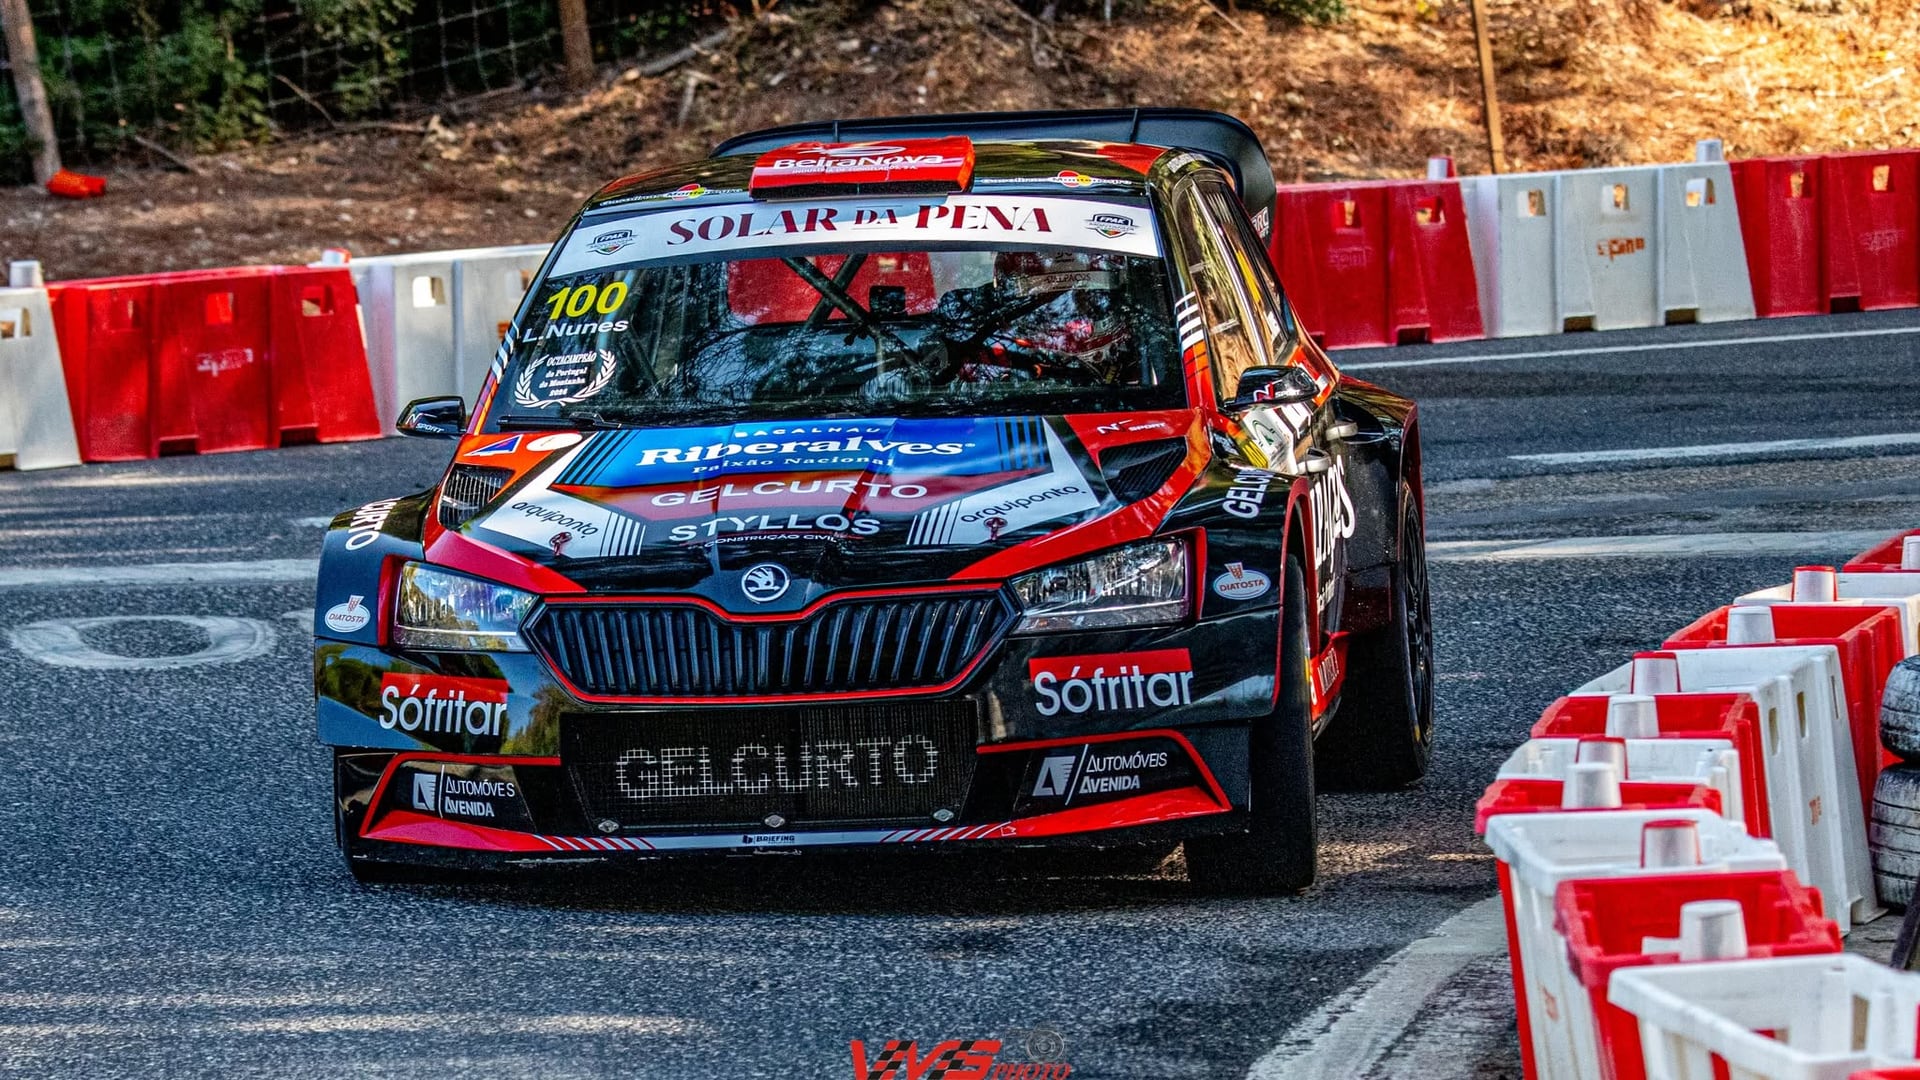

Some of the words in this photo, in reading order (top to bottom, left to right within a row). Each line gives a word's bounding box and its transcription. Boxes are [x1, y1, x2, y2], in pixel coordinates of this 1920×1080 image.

[772, 154, 945, 171] BeiraNova
[666, 207, 839, 246] SOLAR
[853, 207, 899, 225] DA
[914, 204, 1053, 233] PENA
[546, 281, 629, 321] 100
[522, 319, 630, 344] L.Nunes
[554, 366, 589, 377] Portugal
[415, 422, 445, 434] SPORT
[733, 426, 881, 439] BACALHAU
[691, 458, 775, 475] Paixão
[783, 454, 894, 468] Nacional
[650, 478, 929, 507] GELCURTO
[344, 496, 402, 551] CURTO
[667, 512, 882, 543] STYLLOS
[704, 533, 801, 548] CONSTRUÇÃO
[802, 533, 838, 544] CIVIL
[1218, 579, 1266, 592] DIATOSTA
[328, 612, 366, 624] DIATOSTA
[1033, 664, 1196, 718] Sófritar
[378, 683, 508, 737] Sófritar
[615, 733, 940, 800] GELCURTO
[1085, 750, 1169, 773] AUTOMÓVEIS
[1078, 774, 1142, 795] AVENIDA
[444, 795, 496, 818] AVENIDA
[756, 834, 796, 843] BRIEFING
